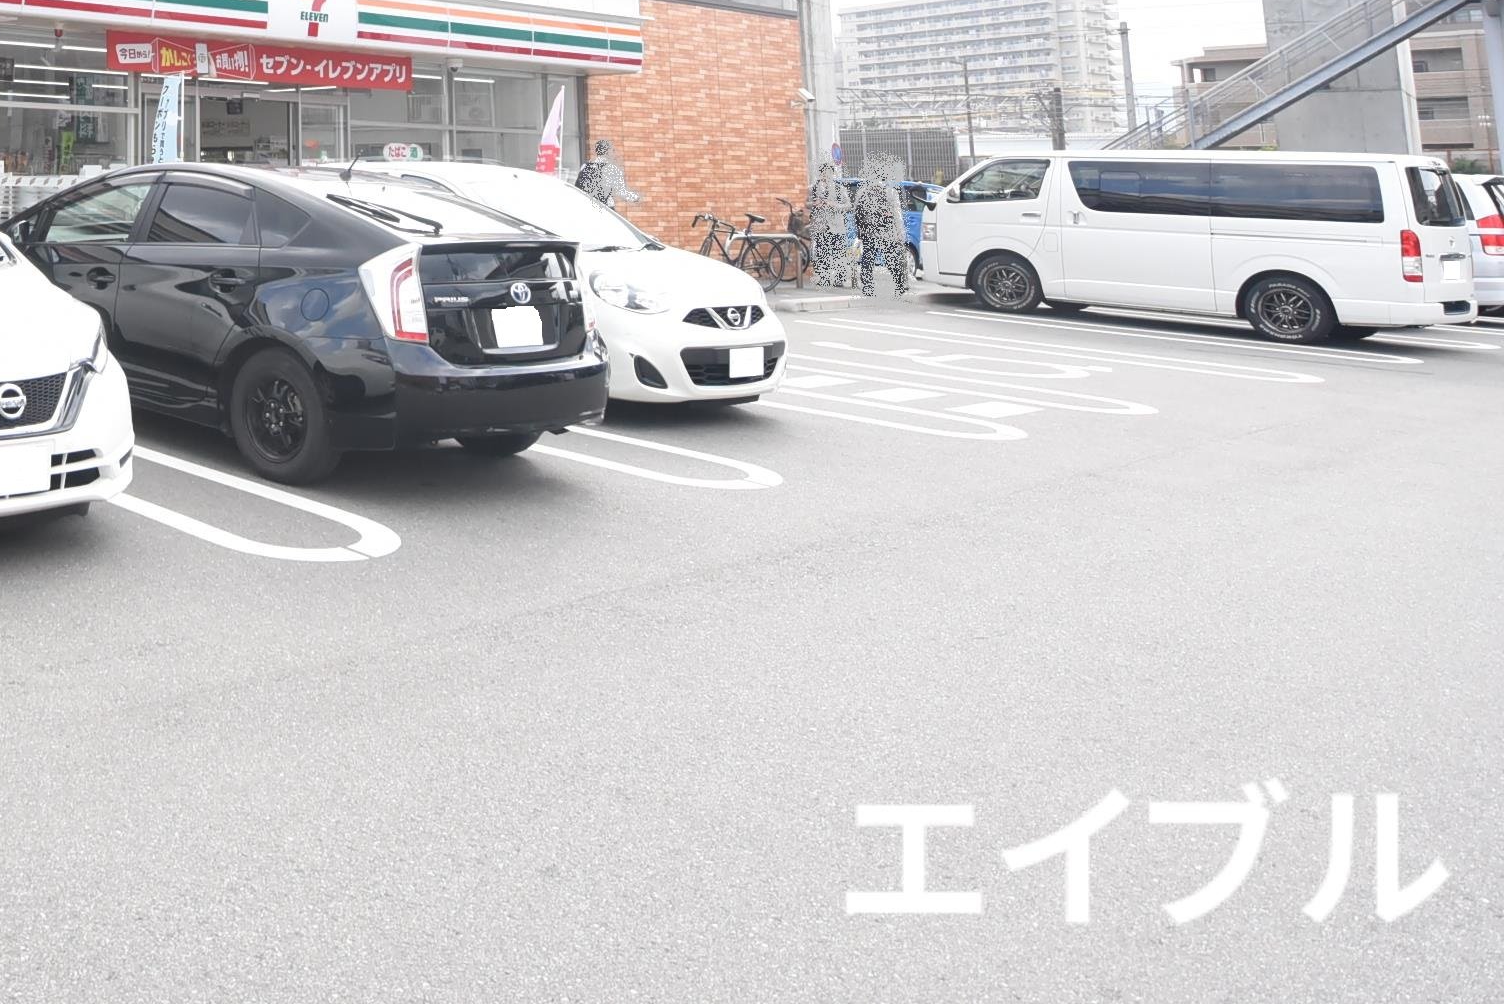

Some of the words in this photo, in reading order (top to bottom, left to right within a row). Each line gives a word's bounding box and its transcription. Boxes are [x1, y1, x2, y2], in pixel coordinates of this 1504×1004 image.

[160, 46, 191, 67] かしこく
[388, 146, 406, 158] たばこ
